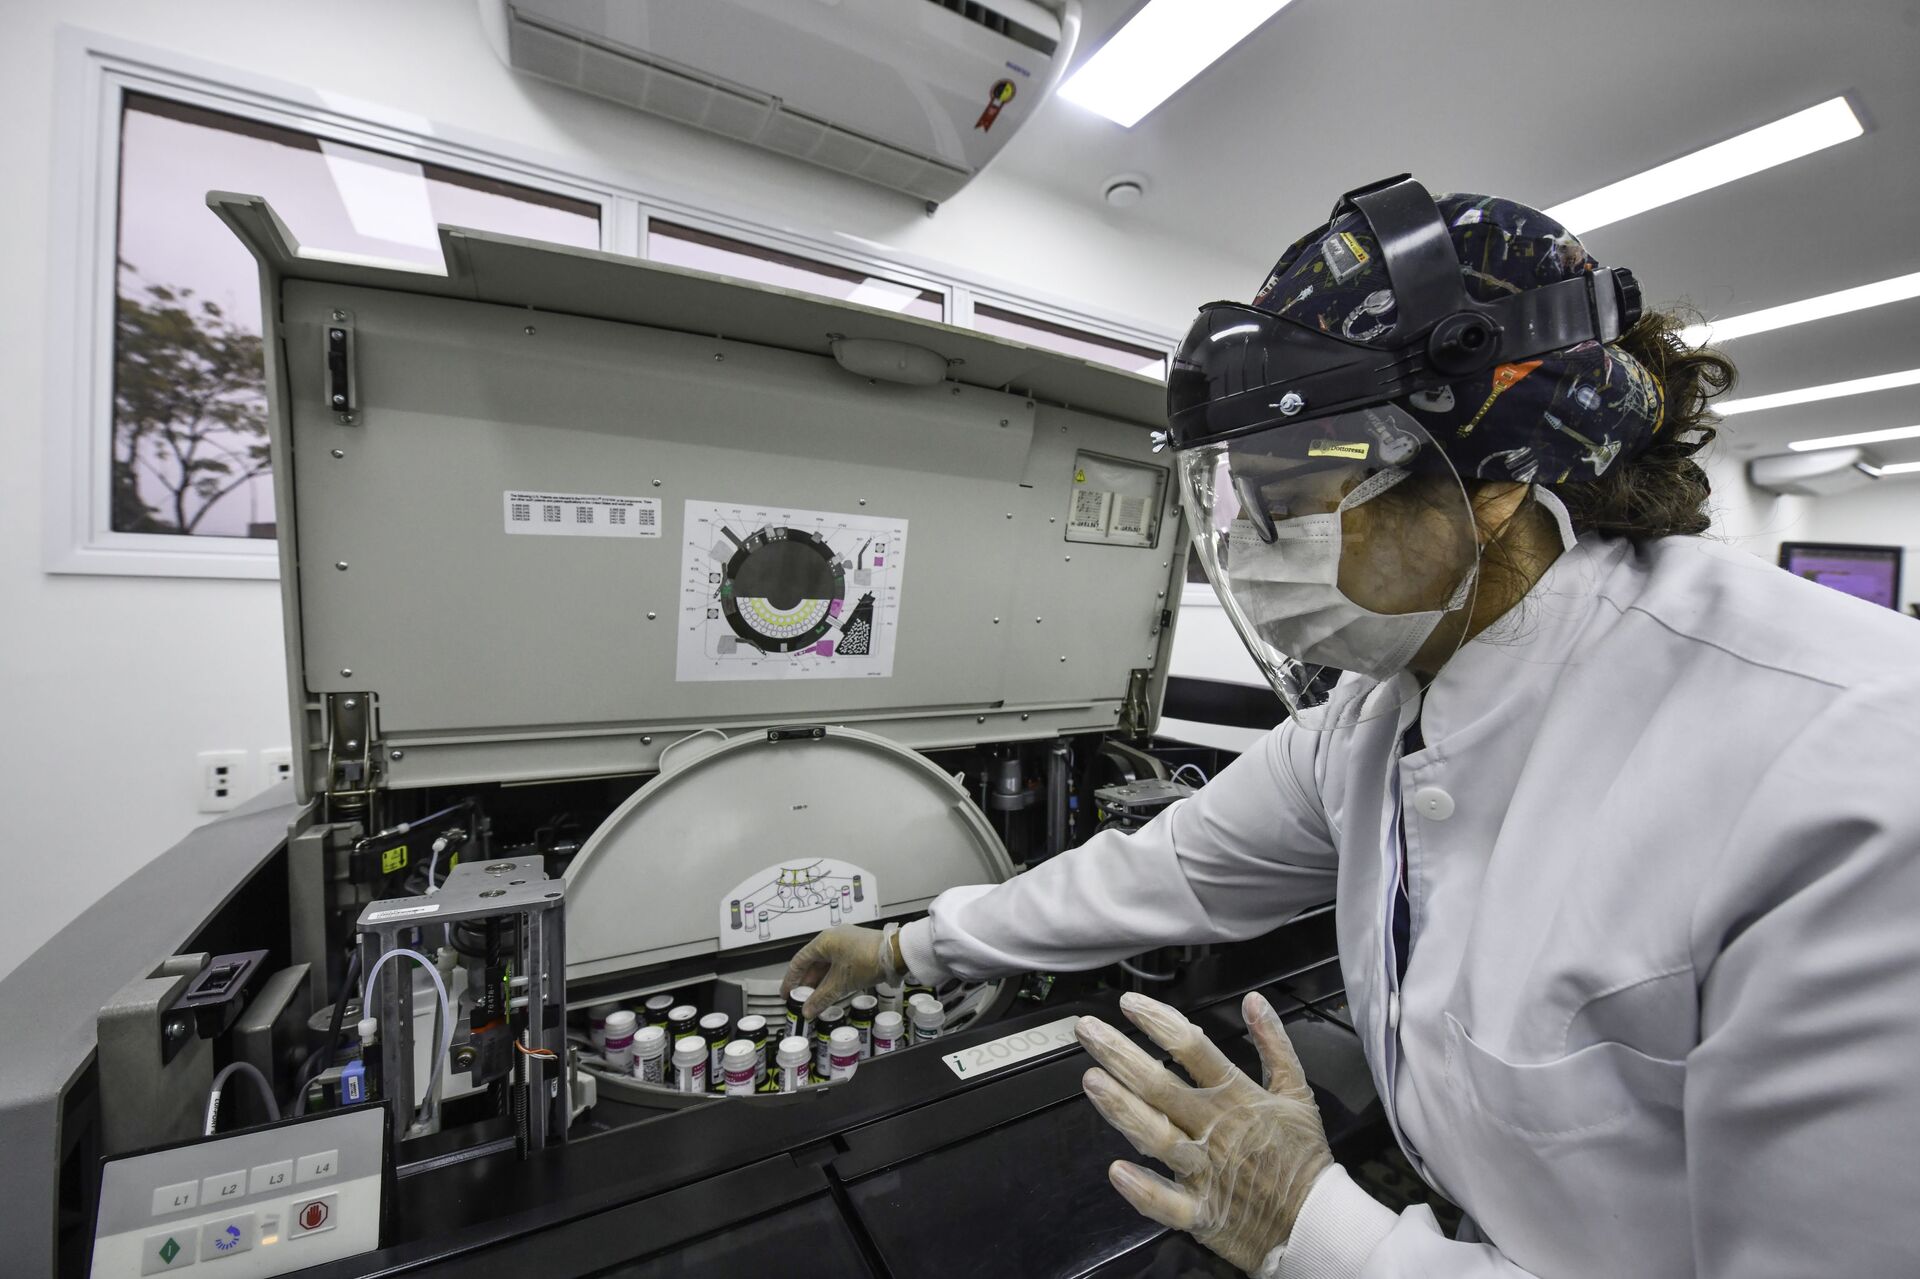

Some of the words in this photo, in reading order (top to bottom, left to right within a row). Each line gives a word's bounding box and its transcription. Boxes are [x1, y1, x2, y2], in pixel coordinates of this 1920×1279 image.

[967, 1030, 1050, 1066] 2000
[174, 1194, 189, 1206] L1
[221, 1184, 237, 1196] L2
[269, 1173, 284, 1185] L3
[315, 1163, 330, 1175] L4
